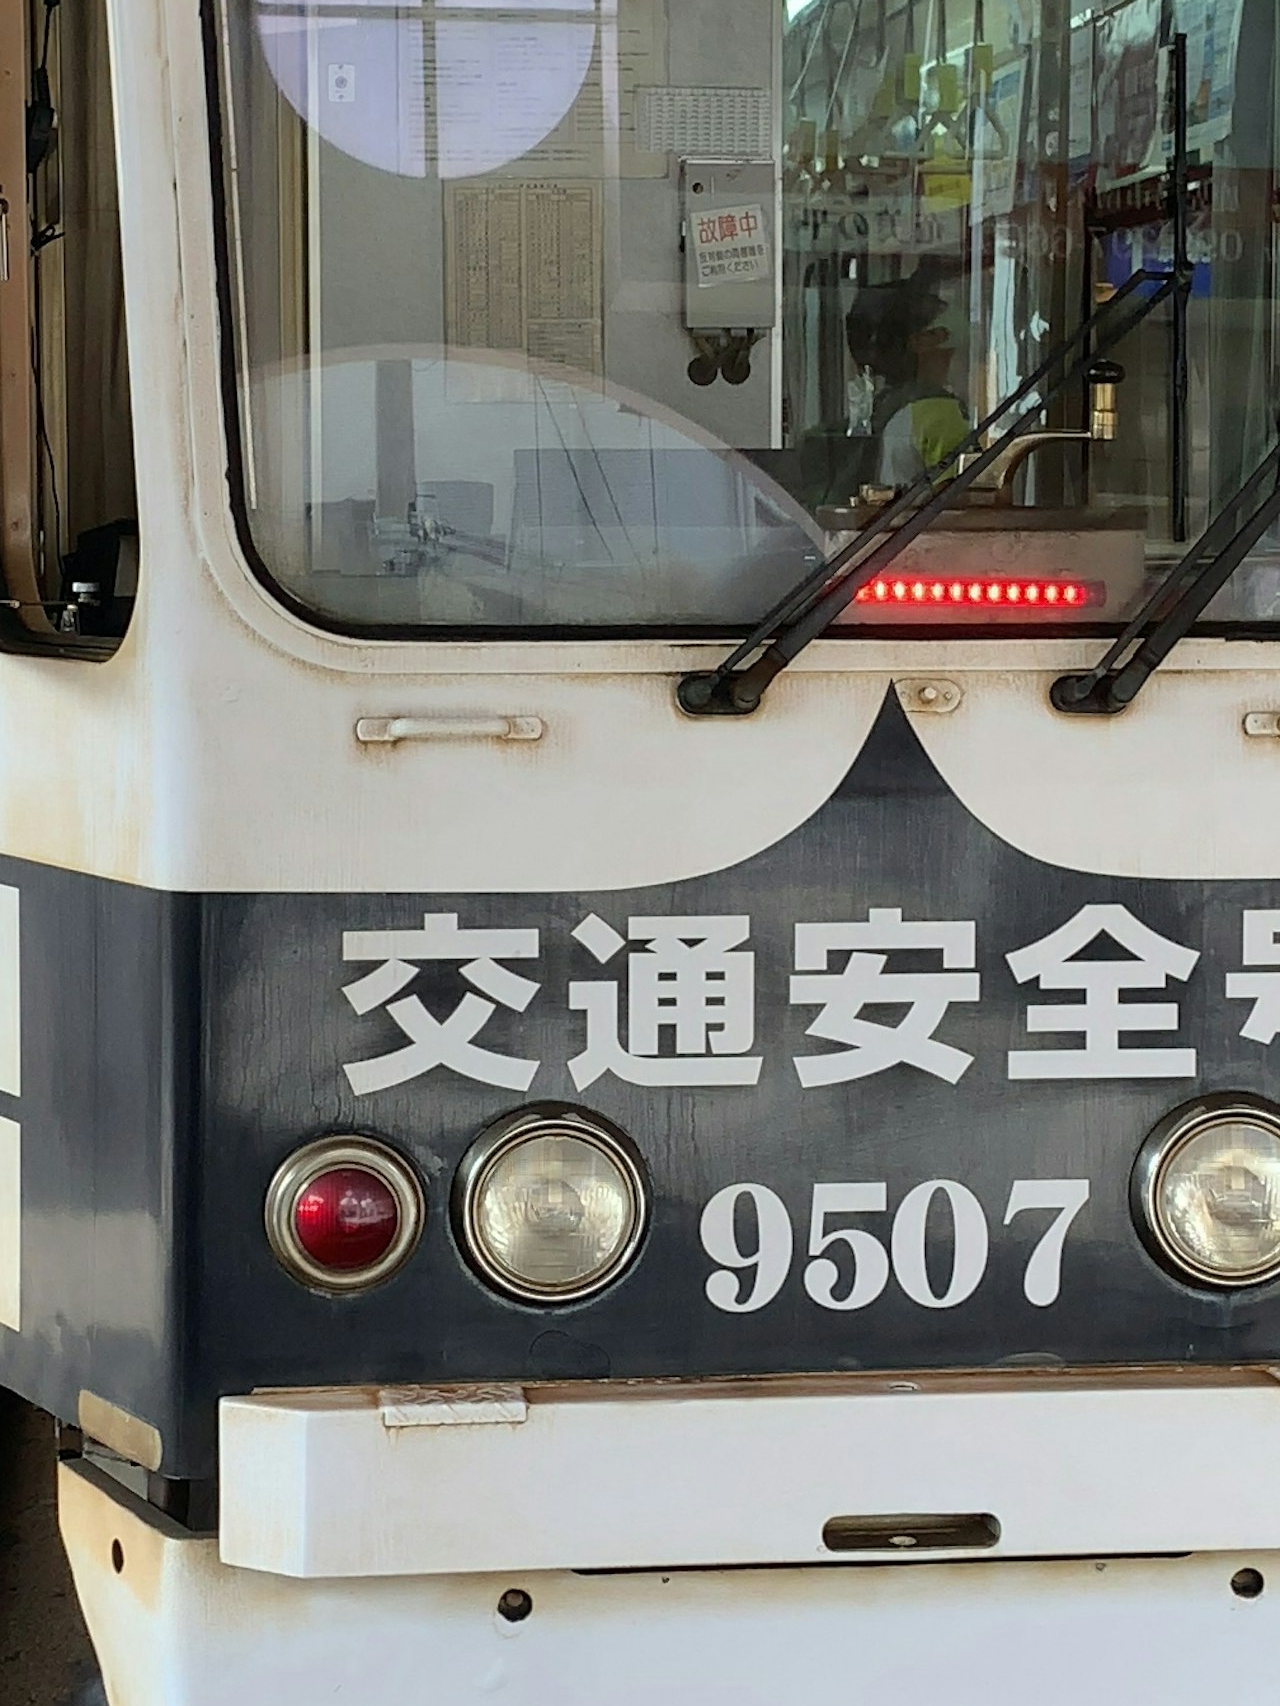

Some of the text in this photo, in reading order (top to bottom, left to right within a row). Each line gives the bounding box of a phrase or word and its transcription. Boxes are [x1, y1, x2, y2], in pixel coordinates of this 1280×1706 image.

[698, 211, 758, 244] 故障中
[699, 1178, 1091, 1313] 9507
